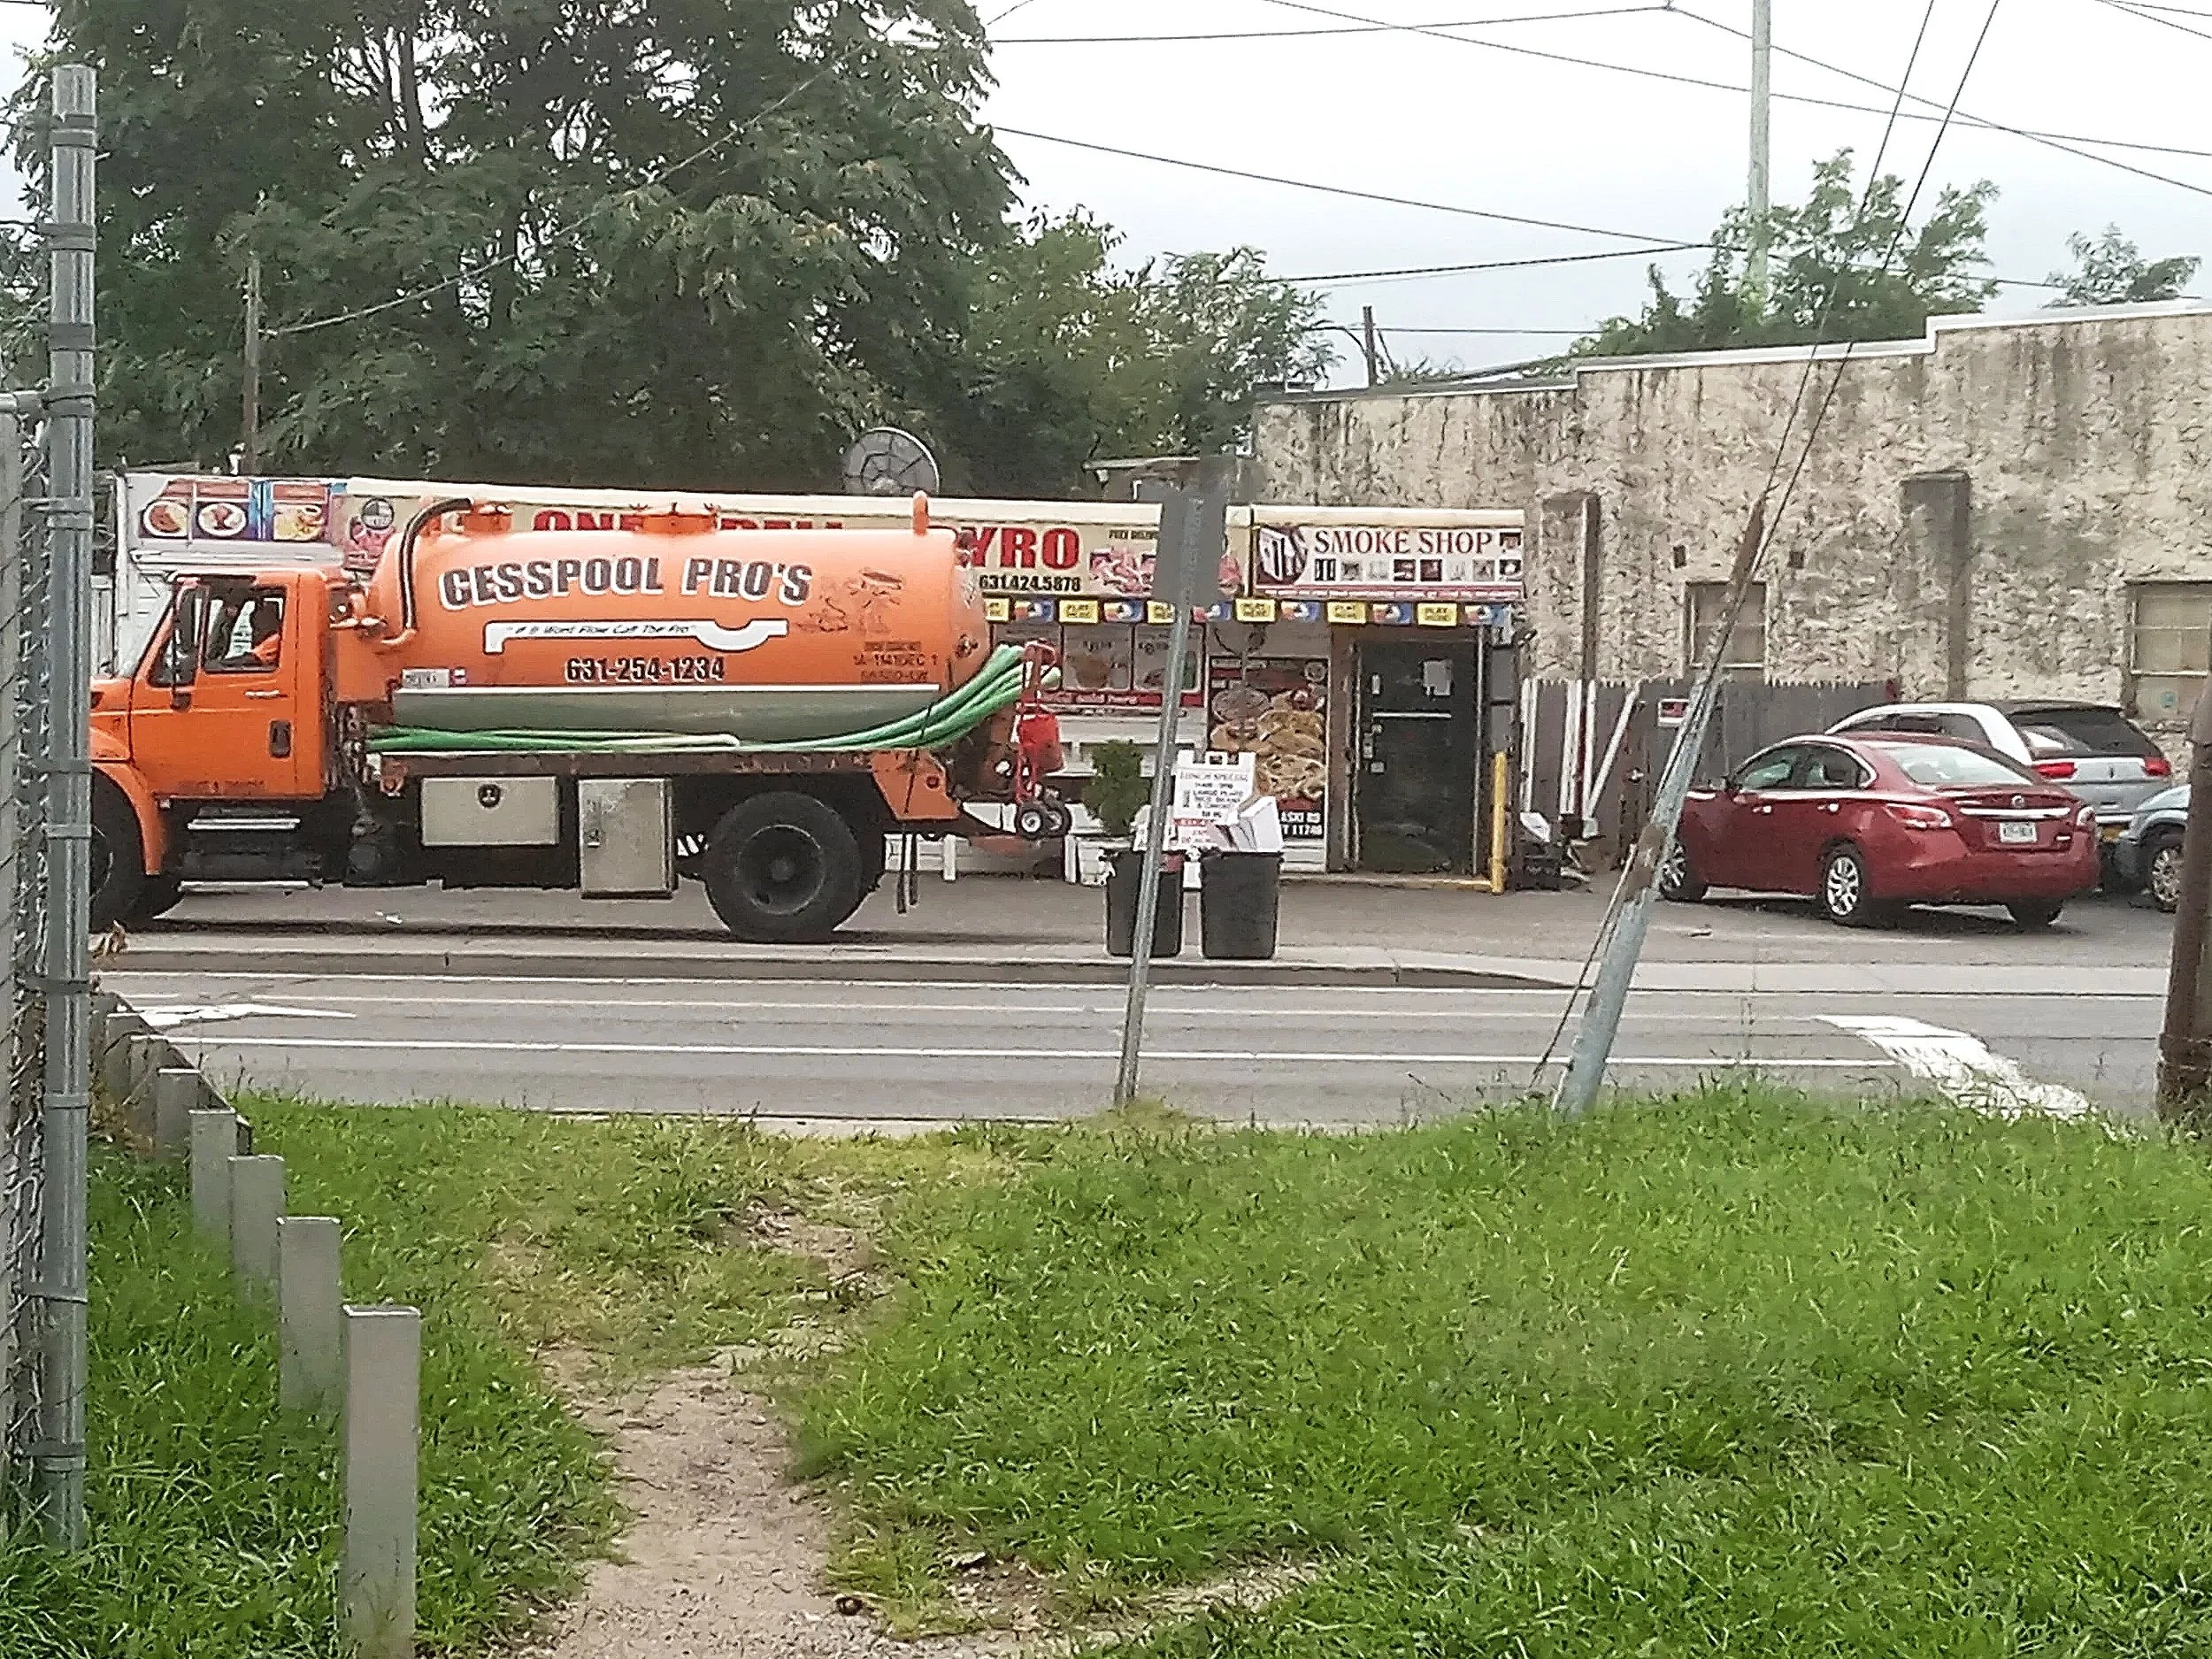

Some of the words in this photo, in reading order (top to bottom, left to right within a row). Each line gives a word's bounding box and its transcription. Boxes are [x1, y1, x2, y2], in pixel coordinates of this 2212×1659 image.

[1314, 530, 1411, 554] SMOKE
[1417, 531, 1493, 555] SHOP
[440, 555, 664, 612] CESSPOOL
[680, 555, 814, 607] PRO'S
[566, 656, 726, 682] 631-254-1234
